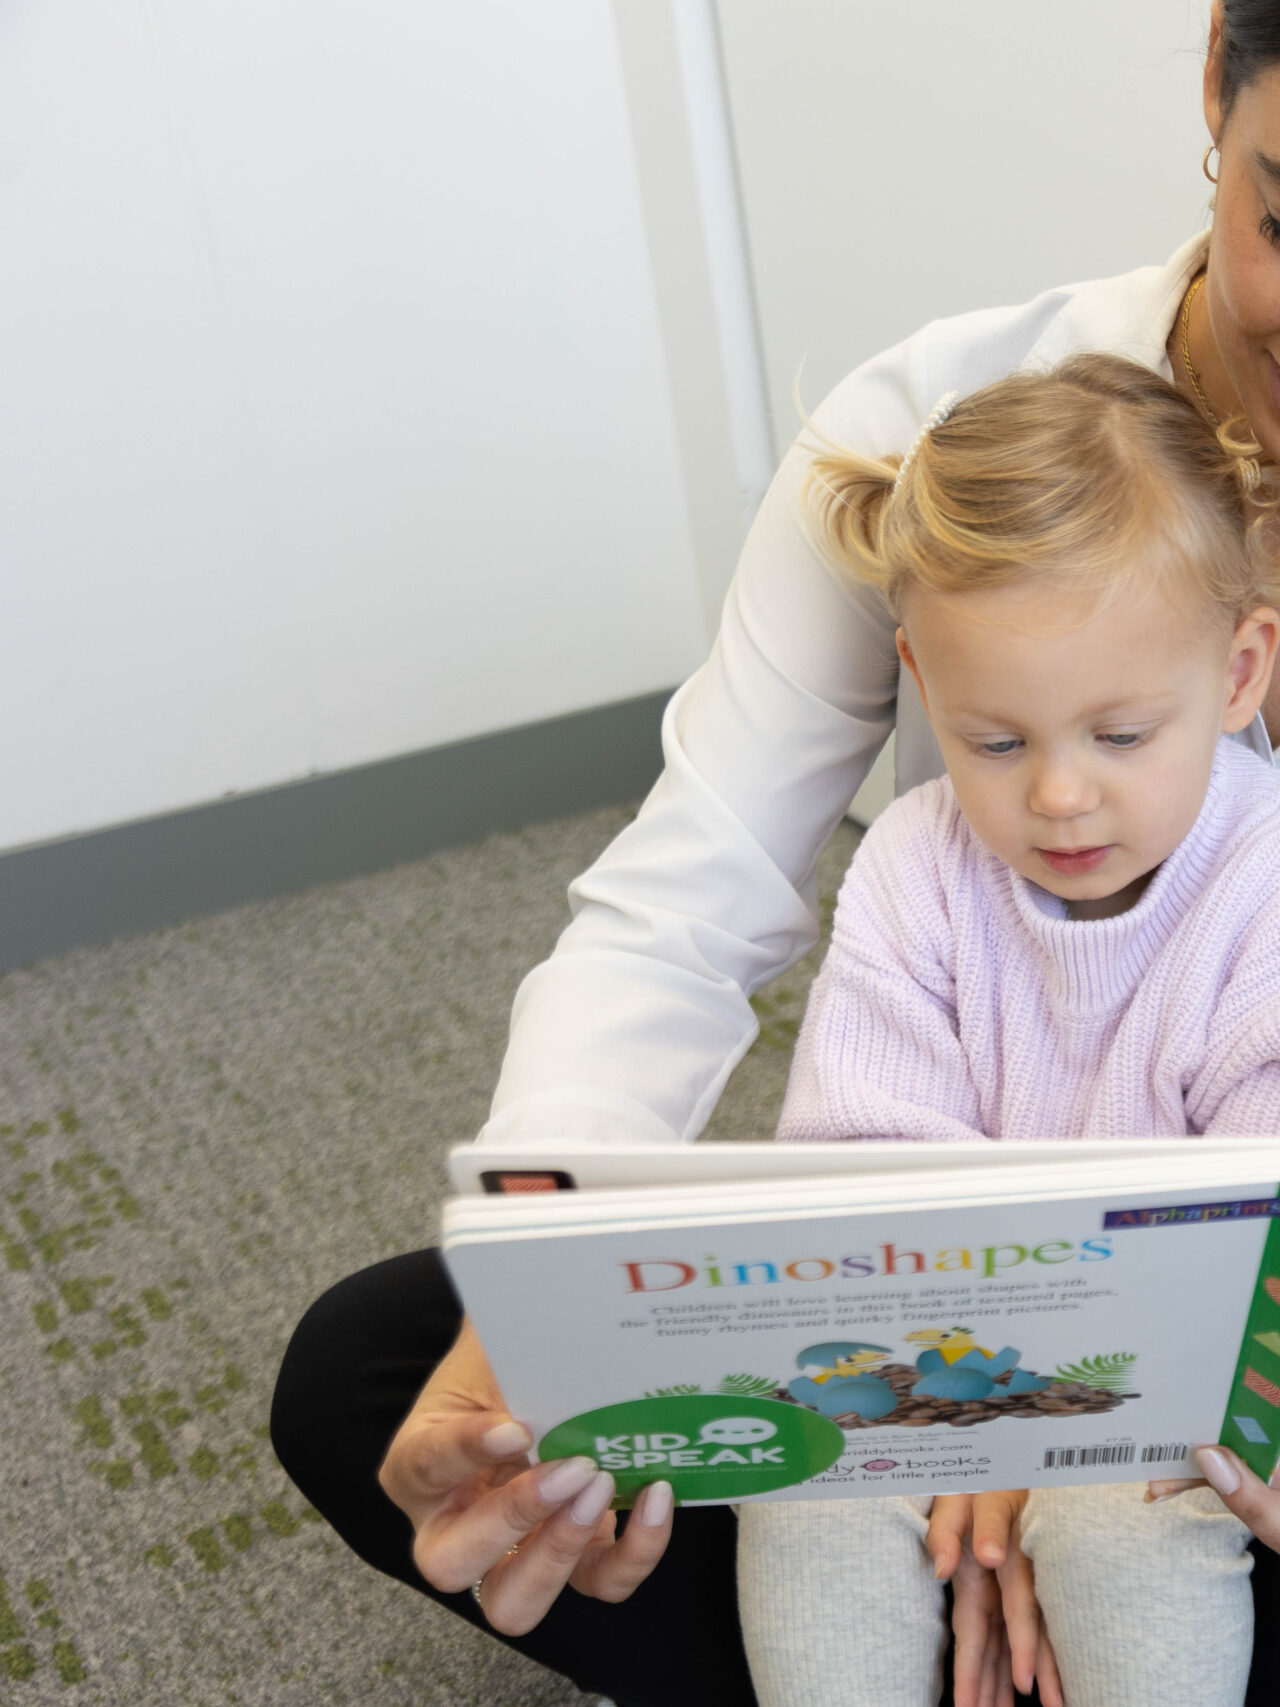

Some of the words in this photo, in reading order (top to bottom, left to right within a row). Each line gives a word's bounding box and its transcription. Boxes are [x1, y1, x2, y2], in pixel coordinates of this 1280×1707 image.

[617, 1237, 1114, 1295] Dinoshapes
[652, 1303, 737, 1315] Children
[743, 1299, 780, 1309] will
[787, 1296, 828, 1306] love
[835, 1291, 912, 1303] learning
[919, 1287, 971, 1297] about
[978, 1282, 1040, 1294] shapes
[1046, 1278, 1088, 1288] with
[619, 1320, 649, 1330] the
[656, 1314, 731, 1327] friendly
[738, 1308, 831, 1321] dinosaurs
[837, 1305, 855, 1314] in
[860, 1303, 895, 1313] this
[901, 1299, 945, 1309] book
[952, 1297, 972, 1307] of
[979, 1292, 1055, 1305] textured
[656, 1328, 712, 1338] funny
[718, 1322, 788, 1334] rhymes
[794, 1318, 829, 1328] and
[834, 1315, 896, 1327] quirky
[903, 1307, 1000, 1321] fingerprint
[594, 1433, 690, 1452] KID
[599, 1446, 786, 1470] SPEAK
[906, 1456, 992, 1469] books
[810, 1473, 856, 1484] ideas
[862, 1473, 884, 1482] for
[891, 1471, 925, 1480] little
[931, 1468, 990, 1480] people
